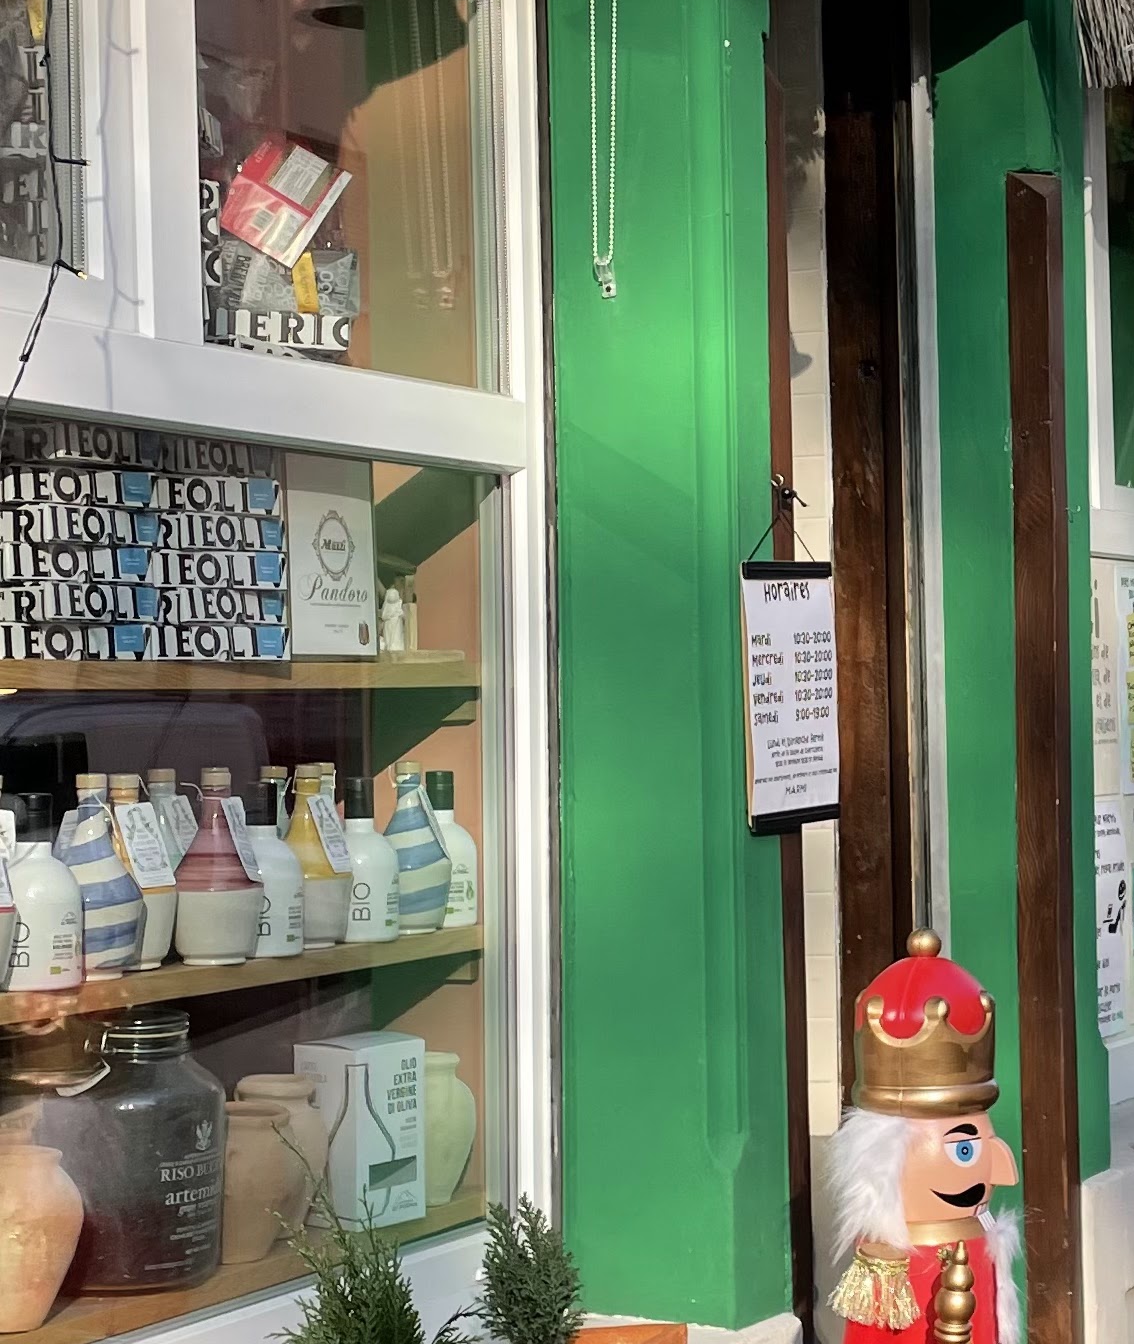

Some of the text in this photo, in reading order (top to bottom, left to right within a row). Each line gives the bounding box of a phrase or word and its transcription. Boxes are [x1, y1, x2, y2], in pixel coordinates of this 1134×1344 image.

[298, 572, 368, 602] Pandoro
[764, 581, 810, 604] Horaires
[751, 634, 772, 647] Mardi
[752, 652, 784, 667] Mercredi
[352, 882, 371, 921] BIO
[401, 1057, 417, 1070] OLIO
[393, 1071, 417, 1086] EXTRA
[386, 1084, 417, 1101] VERGINE
[387, 1098, 417, 1115] DI OLIVA
[160, 1166, 194, 1183] RISO
